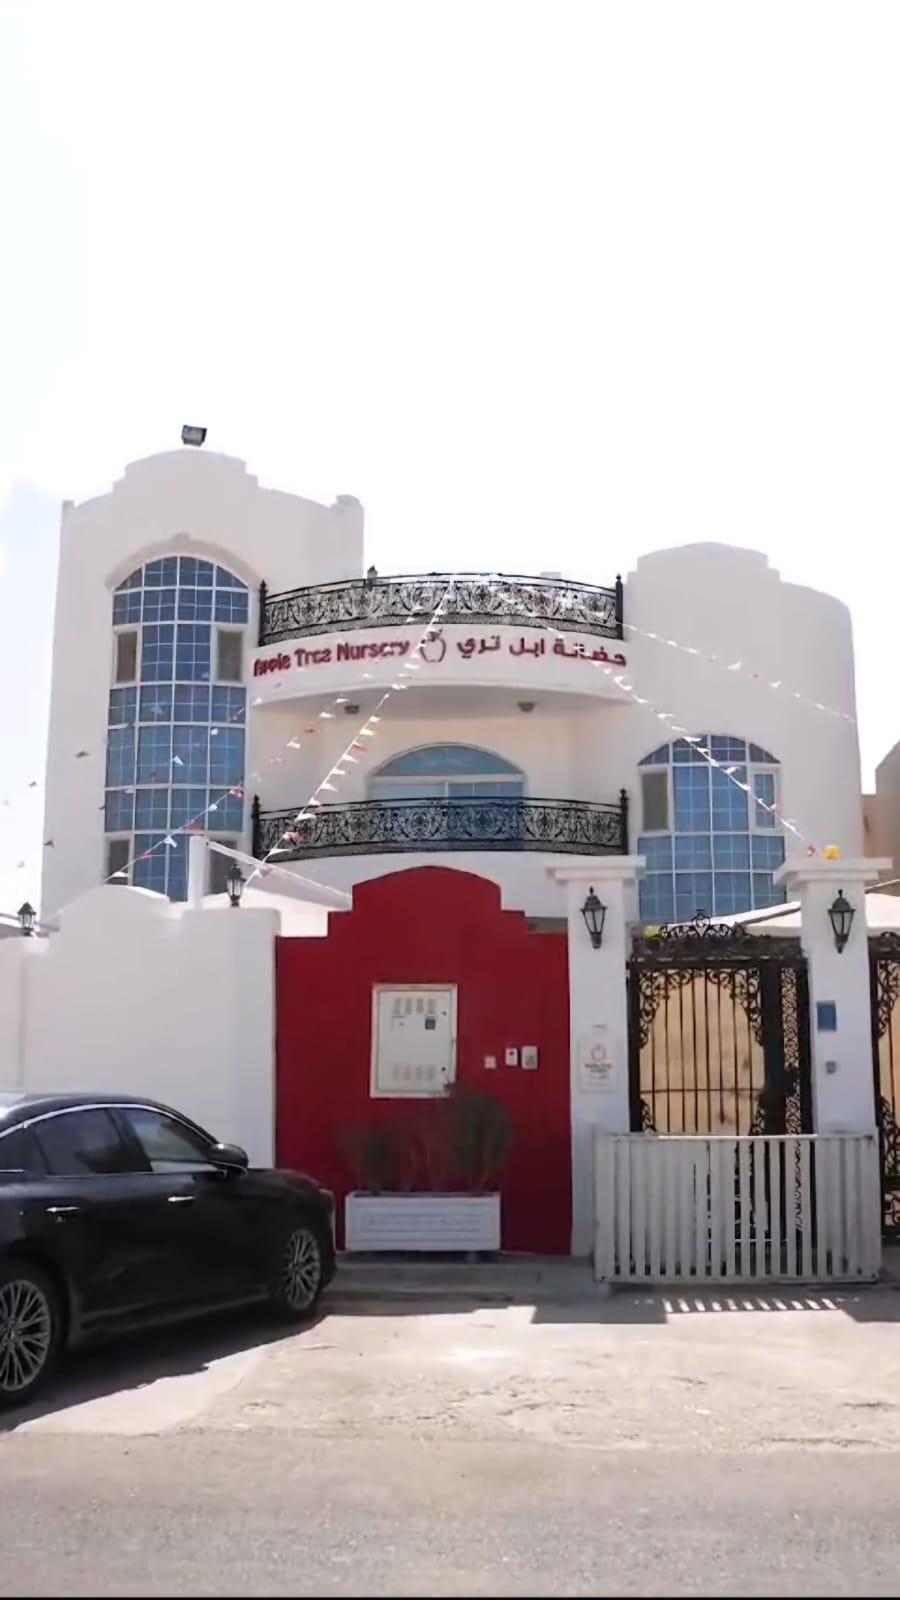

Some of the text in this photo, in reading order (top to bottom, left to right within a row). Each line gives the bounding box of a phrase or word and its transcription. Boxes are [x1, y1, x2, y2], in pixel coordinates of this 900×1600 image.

[294, 647, 332, 667] Tree
[336, 640, 410, 662] Nursery
[457, 635, 501, 659] تري
